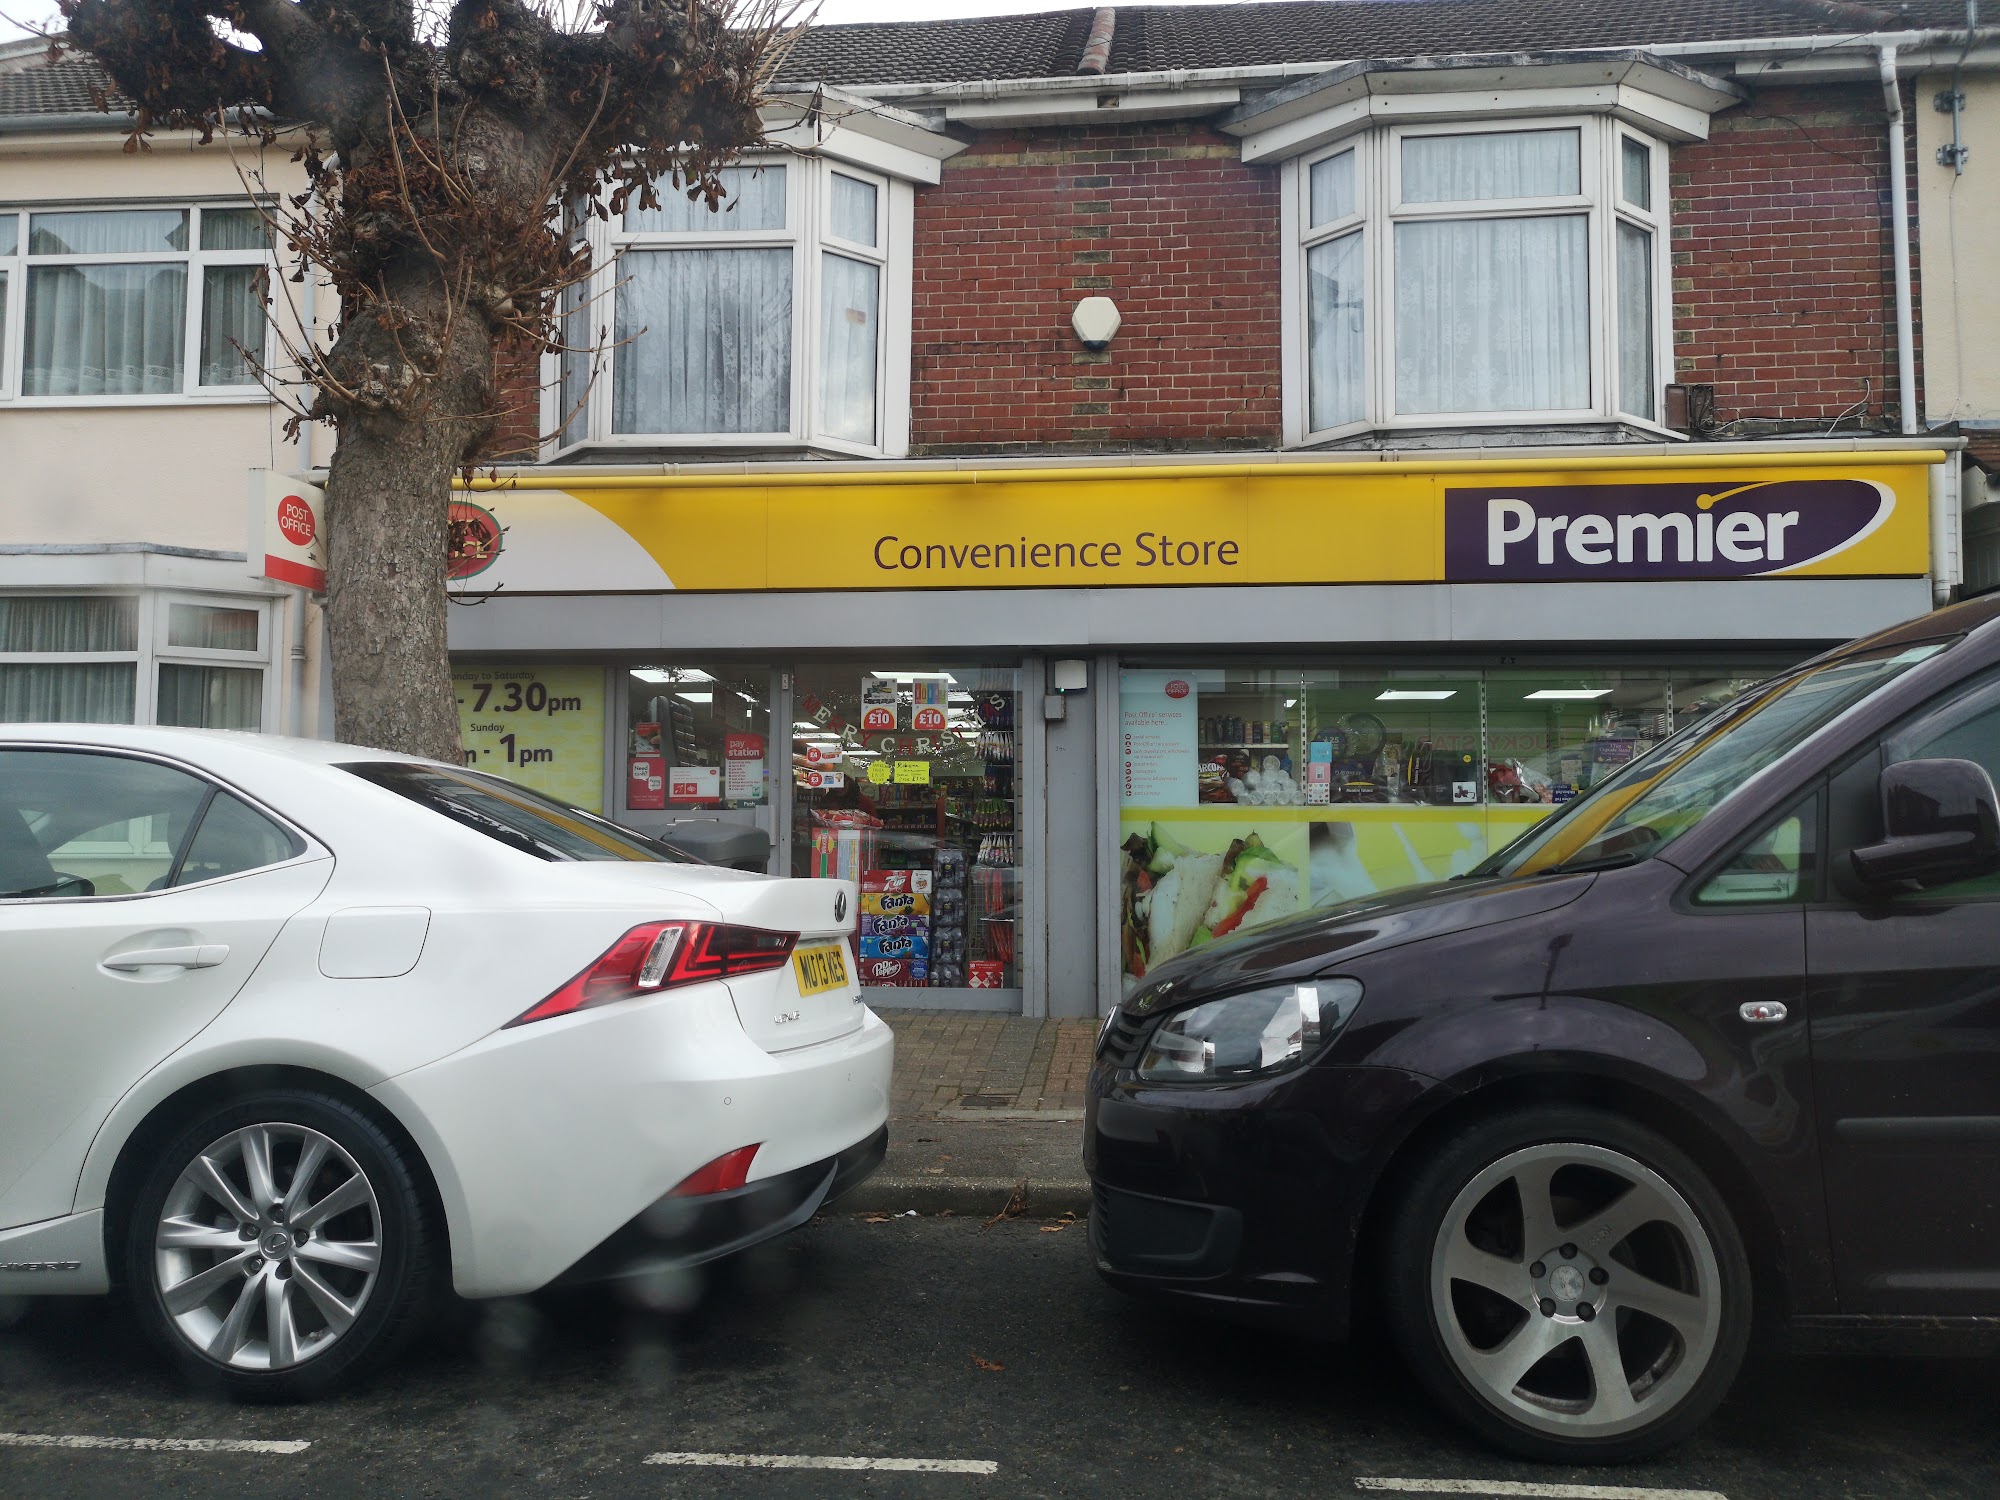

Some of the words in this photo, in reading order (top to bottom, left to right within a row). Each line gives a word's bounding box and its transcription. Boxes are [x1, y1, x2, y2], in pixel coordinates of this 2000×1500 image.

[286, 503, 309, 521] POST
[281, 515, 311, 537] OFFICE
[1488, 498, 1799, 566] Premier
[874, 535, 1121, 569] Convenience
[1135, 532, 1239, 567] Store
[494, 671, 536, 681] Saturday
[472, 682, 581, 716] 7.30pm
[803, 693, 874, 748] MERRY
[881, 693, 1006, 755] CHRISTMAS
[869, 713, 889, 724] £10
[919, 713, 940, 724] £10
[470, 723, 505, 733] Sunday
[500, 733, 553, 767] 1pm
[728, 748, 760, 757] station
[730, 741, 745, 749] pay
[881, 894, 915, 911] Fanta
[873, 915, 909, 935] Fanta
[879, 936, 913, 954] Fanta
[876, 962, 899, 977] Pepper
